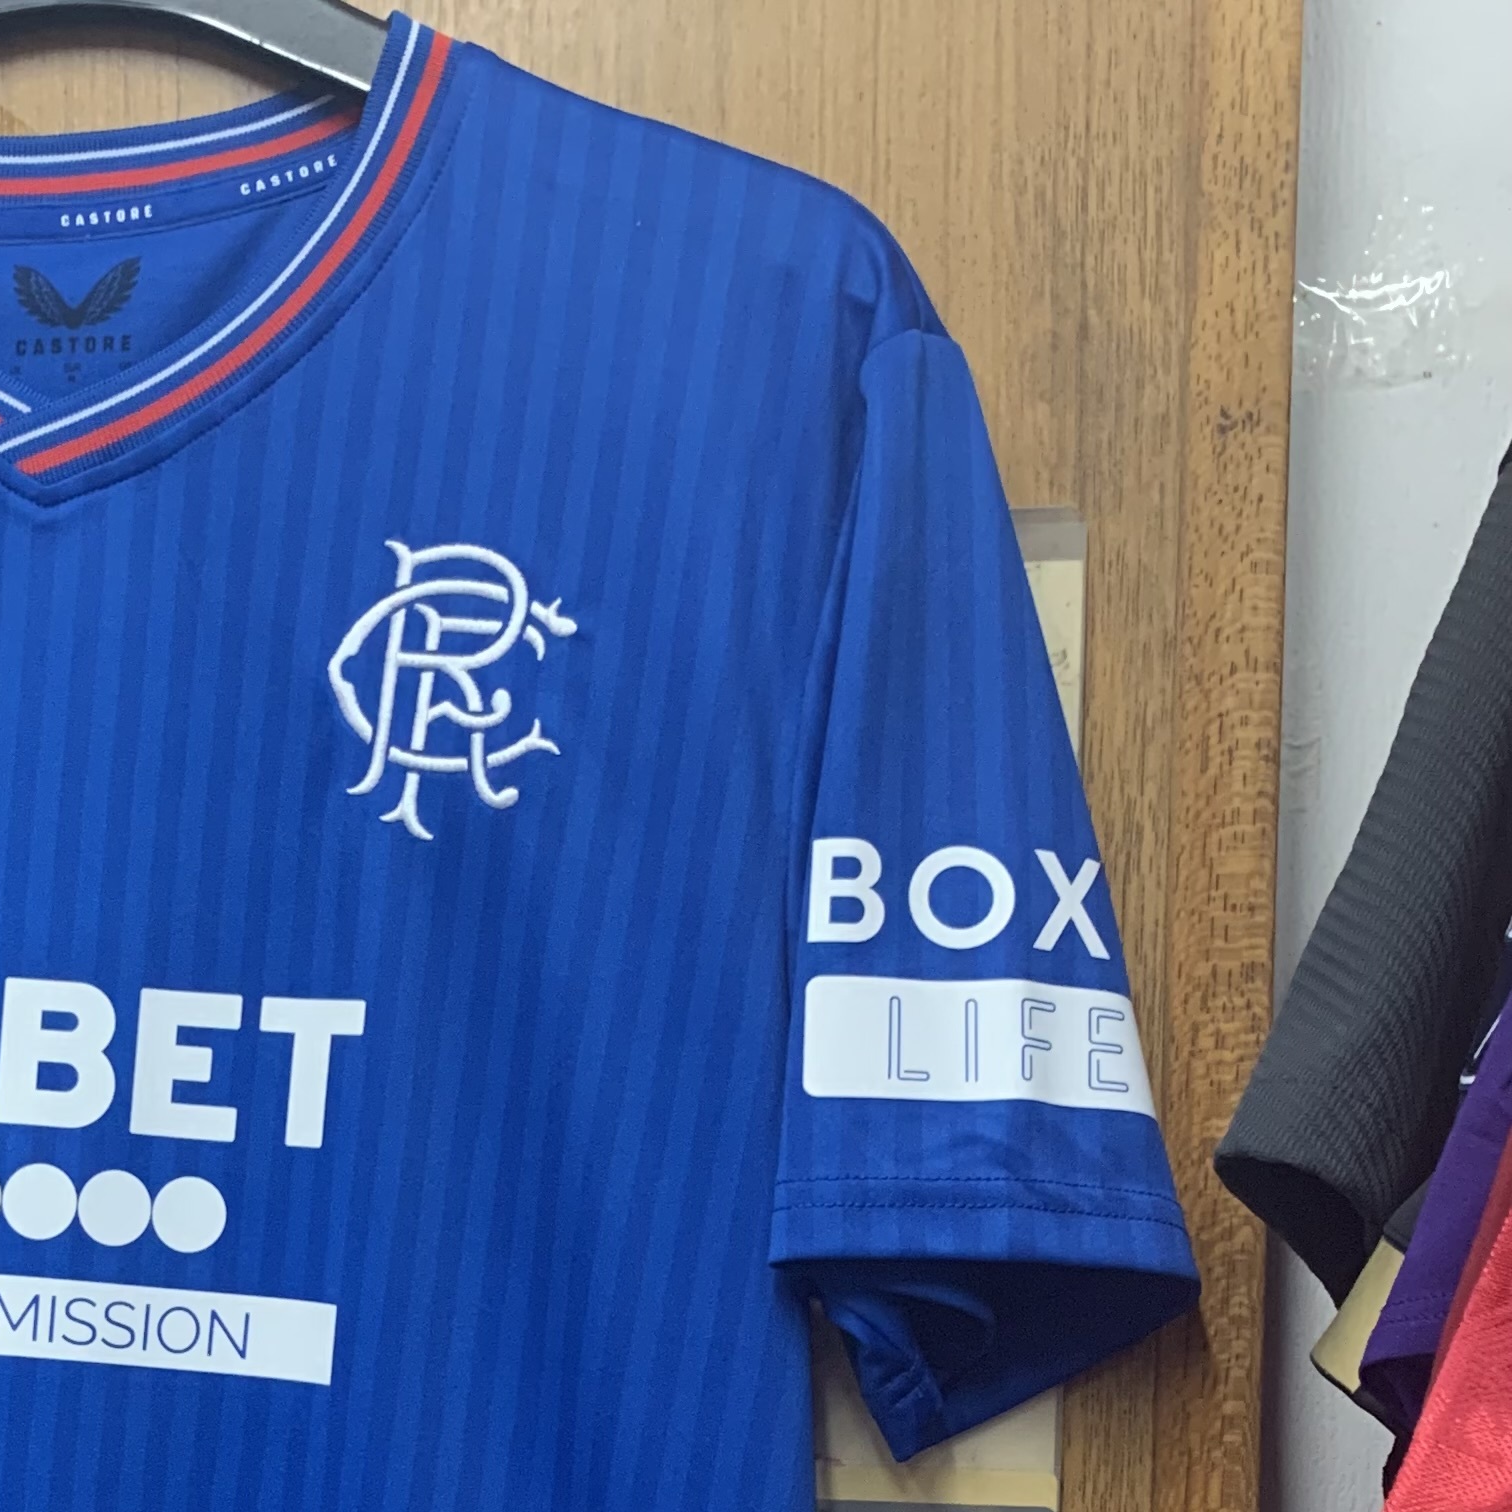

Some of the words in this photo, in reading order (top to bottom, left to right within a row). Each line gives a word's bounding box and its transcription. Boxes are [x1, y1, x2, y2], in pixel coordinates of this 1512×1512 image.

[240, 154, 337, 196] CASTORE
[61, 204, 153, 227] CASTORE
[15, 334, 132, 356] CASTORE
[807, 837, 1111, 960] BOX
[888, 995, 1130, 1093] LIFE
